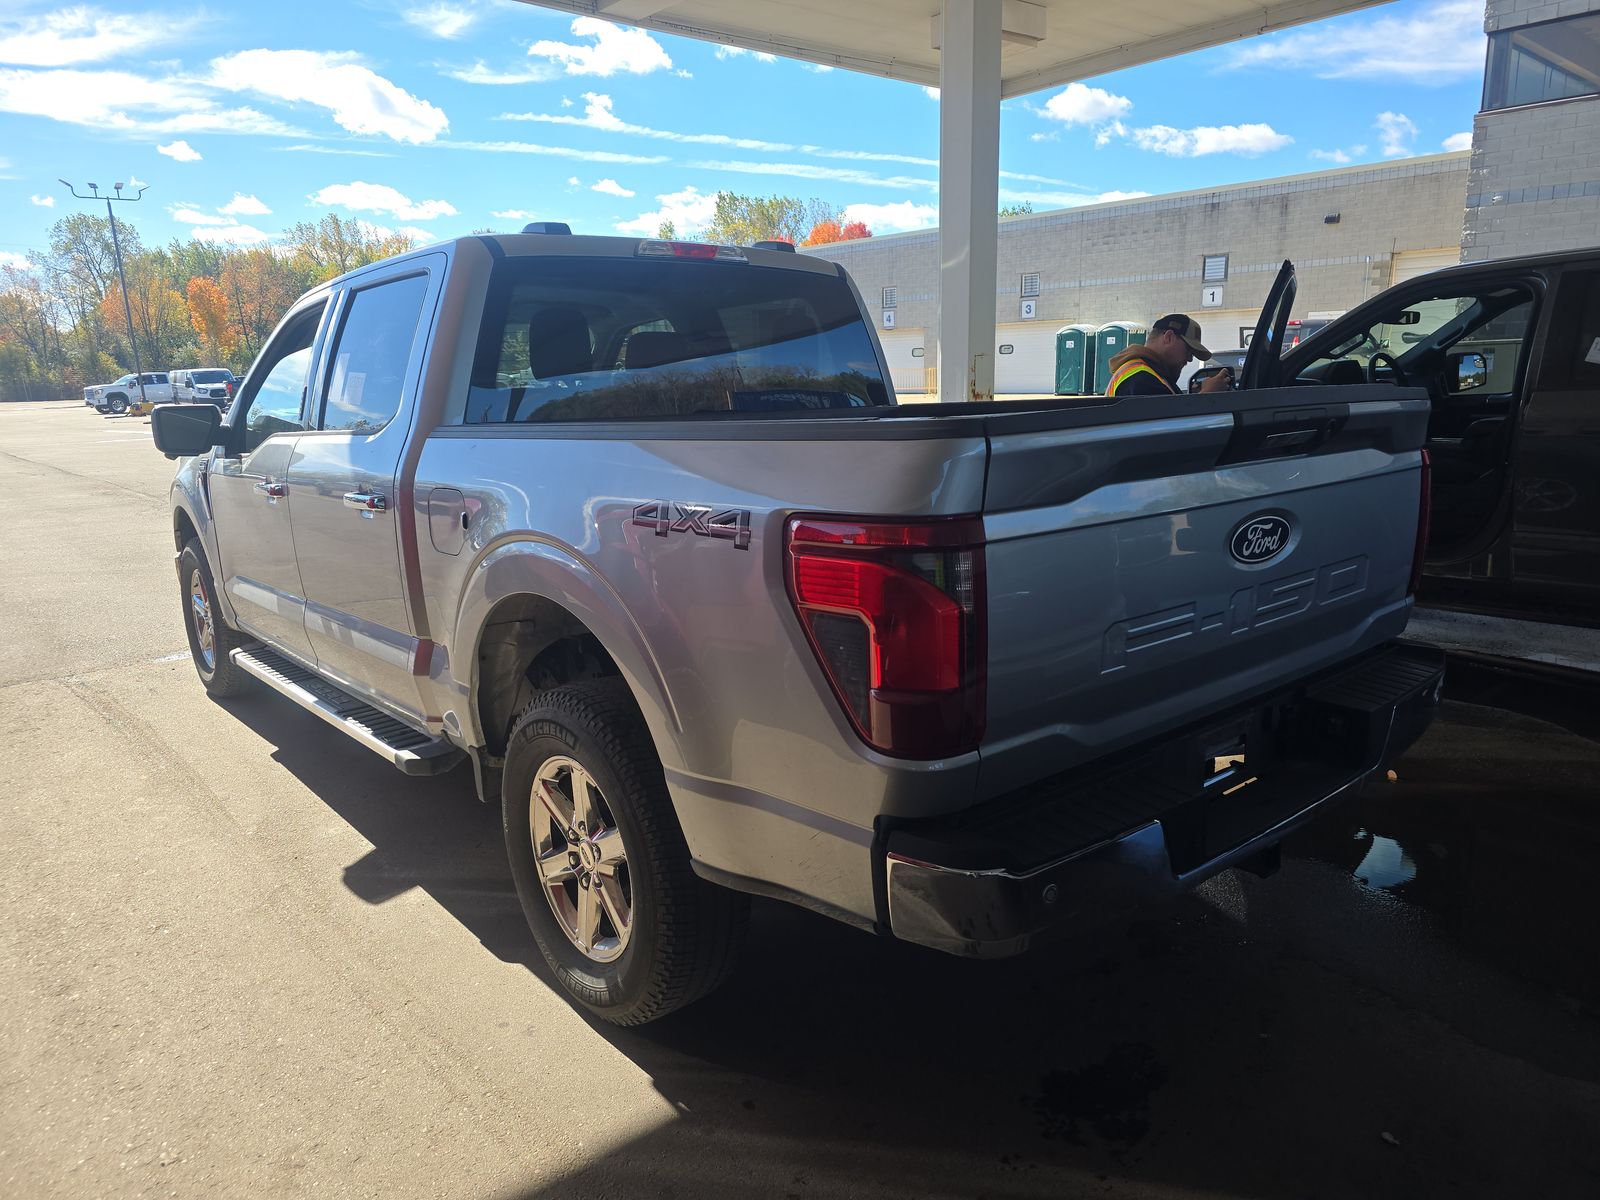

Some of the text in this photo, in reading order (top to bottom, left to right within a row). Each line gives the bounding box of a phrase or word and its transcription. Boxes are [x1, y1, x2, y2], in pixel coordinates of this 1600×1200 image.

[1209, 290, 1215, 303] 1
[885, 313, 892, 324] 4
[1025, 304, 1032, 315] 3
[1242, 522, 1282, 556] Ford
[1101, 553, 1368, 675] F-150
[525, 720, 576, 748] MICHELIN
